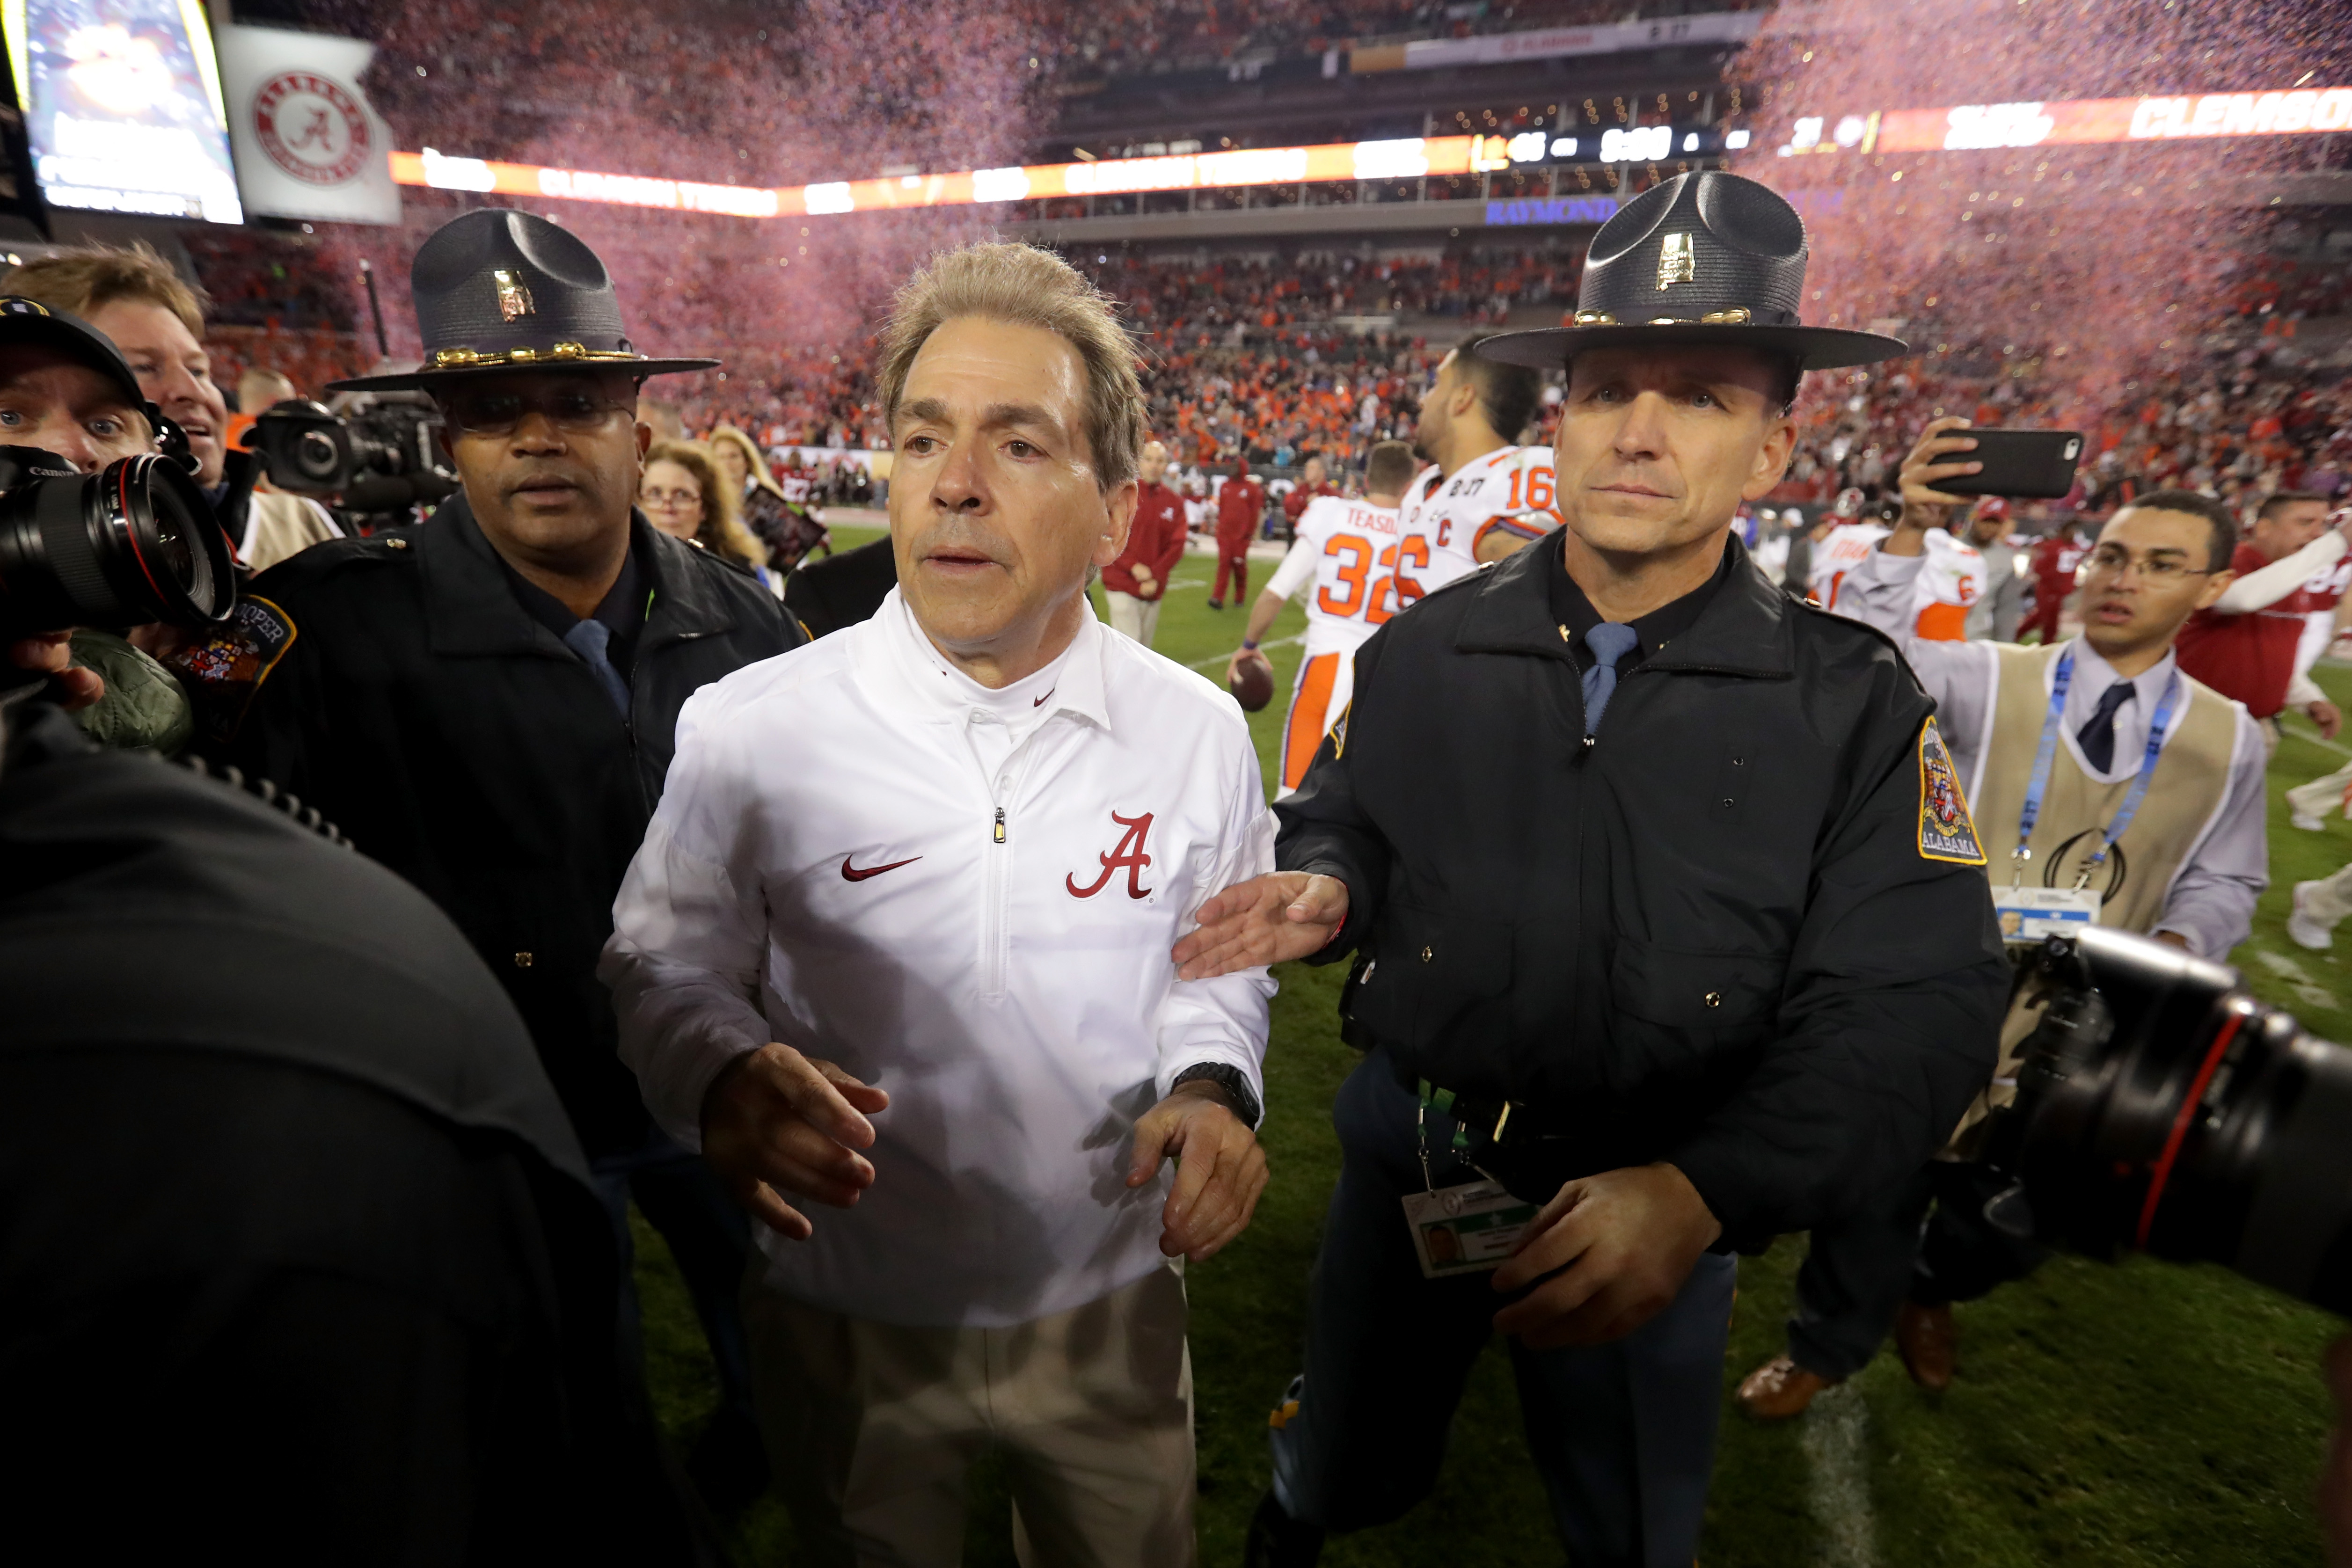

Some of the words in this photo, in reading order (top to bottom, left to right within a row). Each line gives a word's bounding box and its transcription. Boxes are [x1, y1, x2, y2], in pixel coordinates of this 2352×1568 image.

[29, 467, 75, 477] Canon
[1506, 467, 1555, 510] 16
[1437, 519, 1452, 547] C
[1318, 533, 1398, 624] 32
[1066, 810, 1154, 899] A
[1922, 831, 1979, 856] ALABAMA
